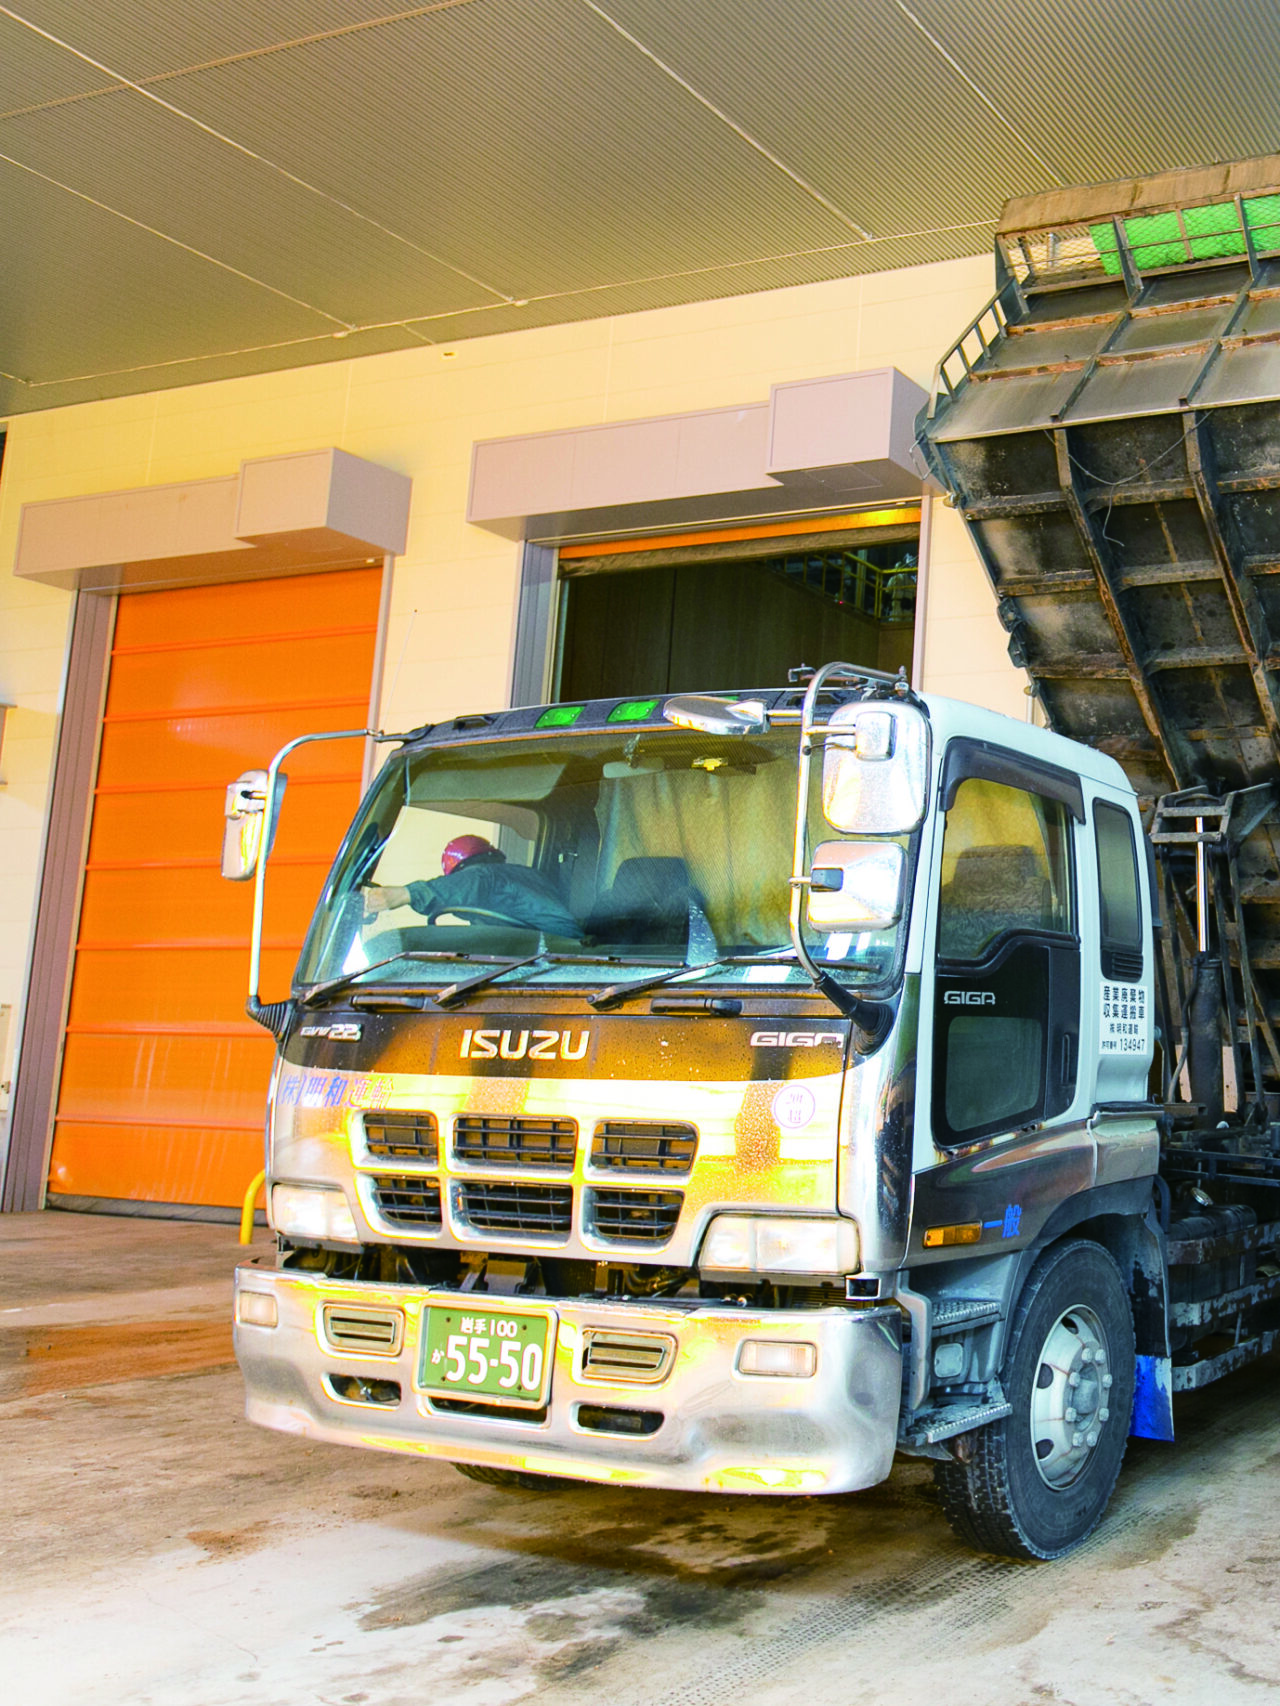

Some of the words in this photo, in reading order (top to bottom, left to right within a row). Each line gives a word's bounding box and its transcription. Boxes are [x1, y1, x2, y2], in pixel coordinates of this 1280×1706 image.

[944, 990, 996, 1005] GIGA
[459, 1029, 590, 1060] ISUZU
[750, 1031, 844, 1048] GIGA
[1120, 1038, 1145, 1051] 134947
[983, 1203, 1022, 1239] 一般
[445, 1334, 543, 1391] 55-50
